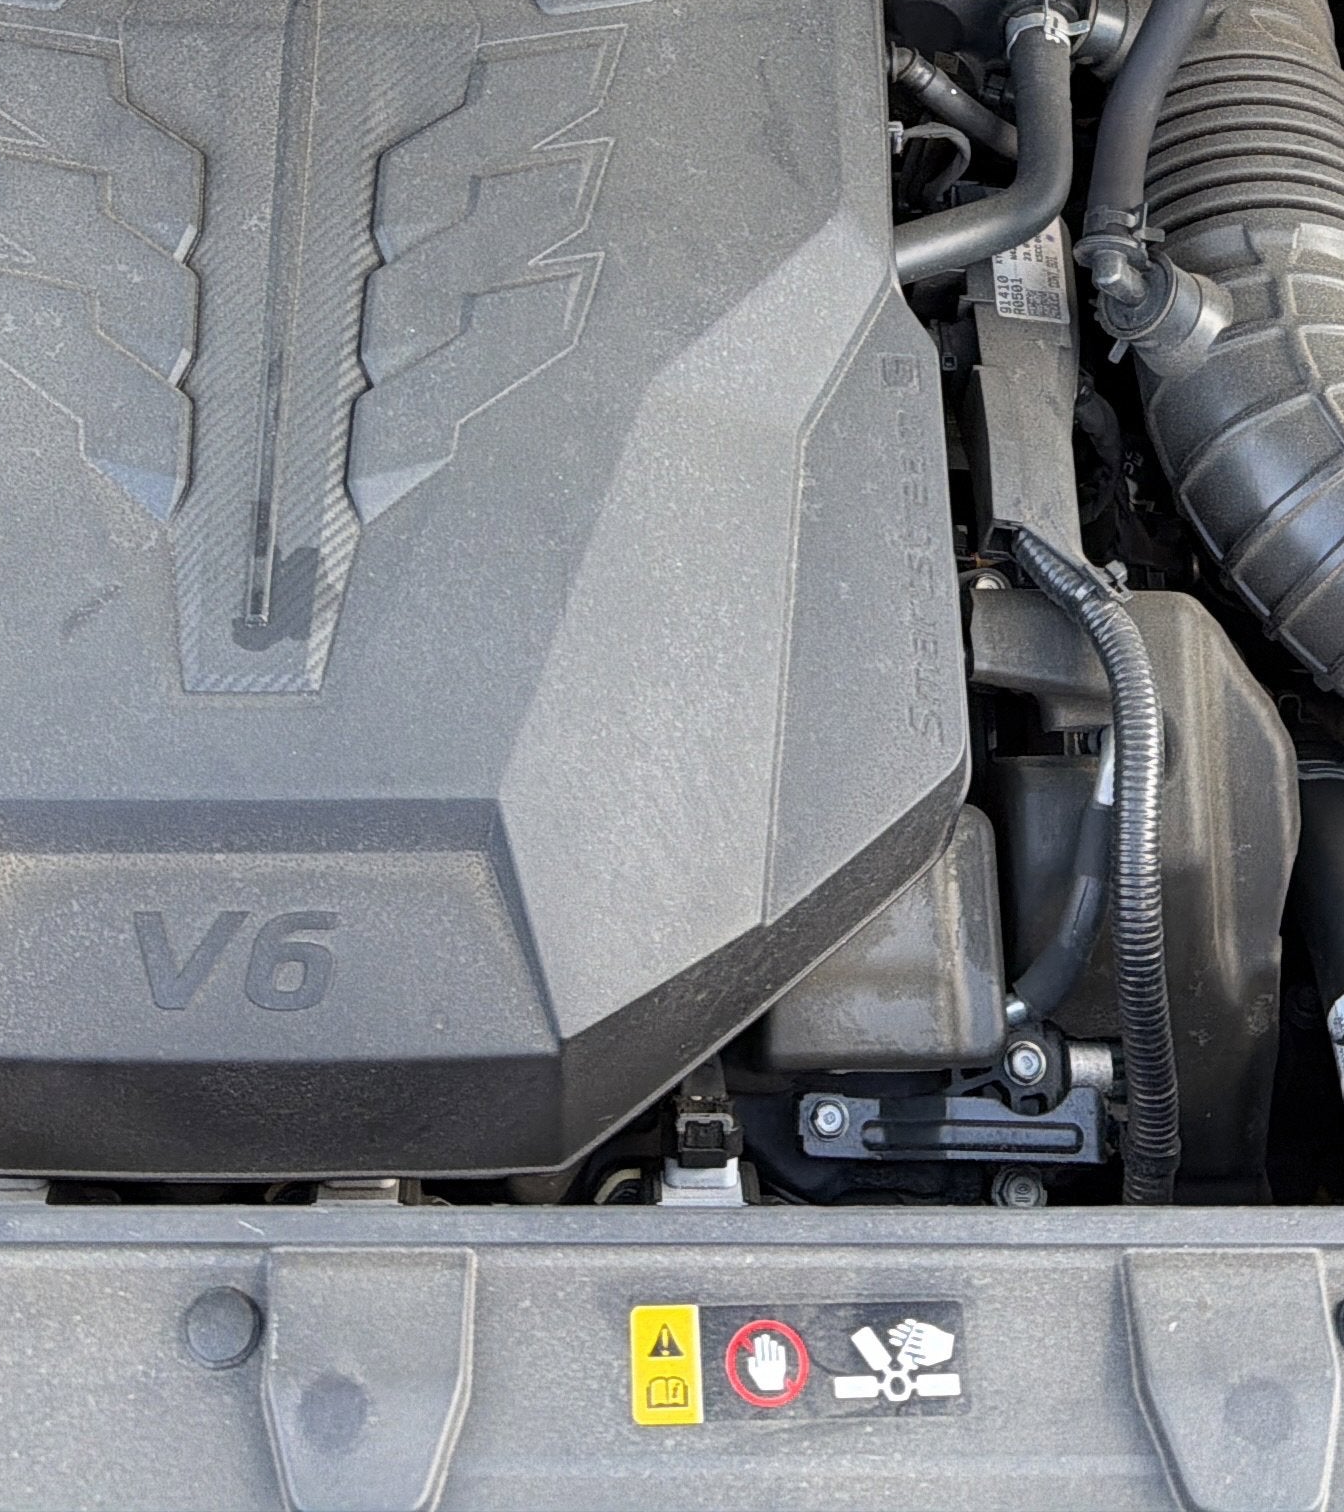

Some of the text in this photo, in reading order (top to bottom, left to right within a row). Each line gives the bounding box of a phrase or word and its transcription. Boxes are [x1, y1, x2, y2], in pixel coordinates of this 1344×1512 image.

[996, 274, 1012, 314] 91410
[1010, 276, 1027, 316] R0501
[132, 909, 341, 1011] V6
